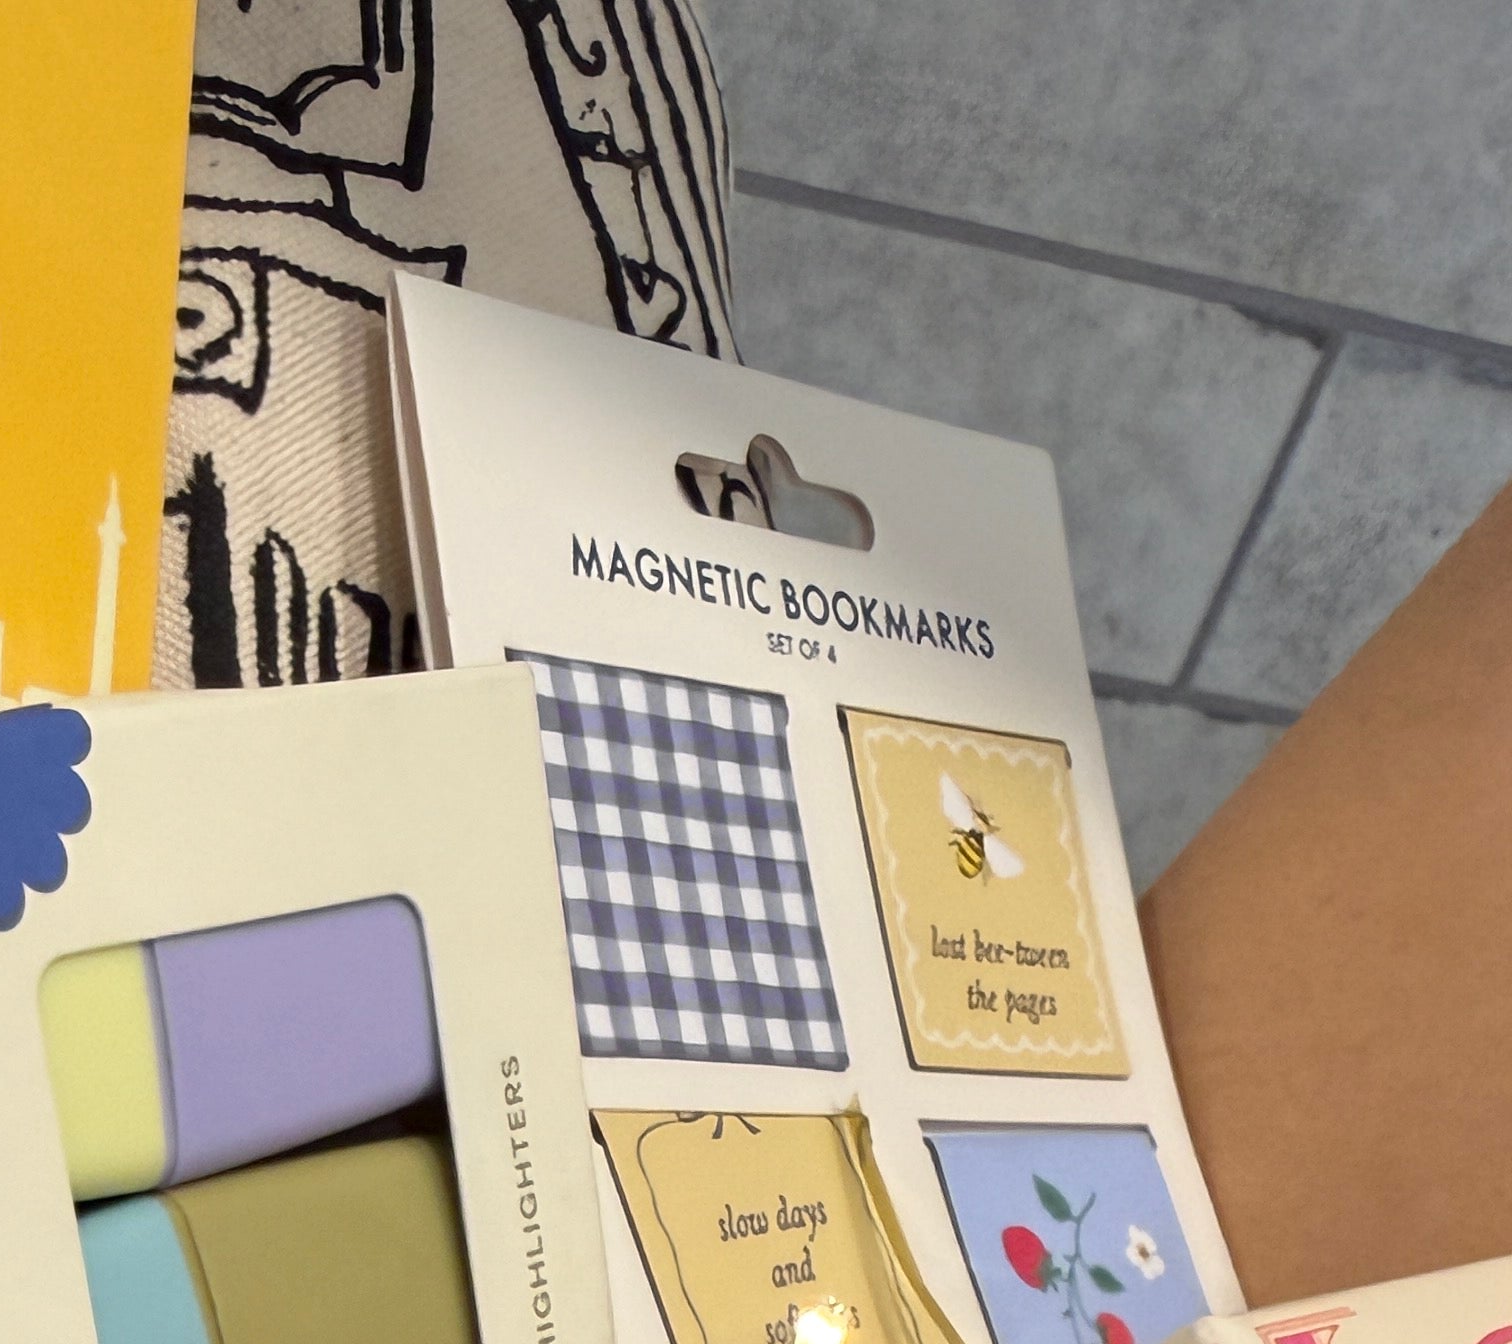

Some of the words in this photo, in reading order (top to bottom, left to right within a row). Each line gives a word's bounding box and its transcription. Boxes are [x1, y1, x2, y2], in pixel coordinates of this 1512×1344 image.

[571, 532, 772, 615] MAGNETIC
[781, 577, 996, 660] BOOKMARKS
[930, 924, 967, 962] lost
[967, 978, 999, 1013] the
[1004, 988, 1057, 1026] pages
[717, 1203, 770, 1242] slow
[776, 1194, 828, 1242] days
[771, 1246, 816, 1288] and
